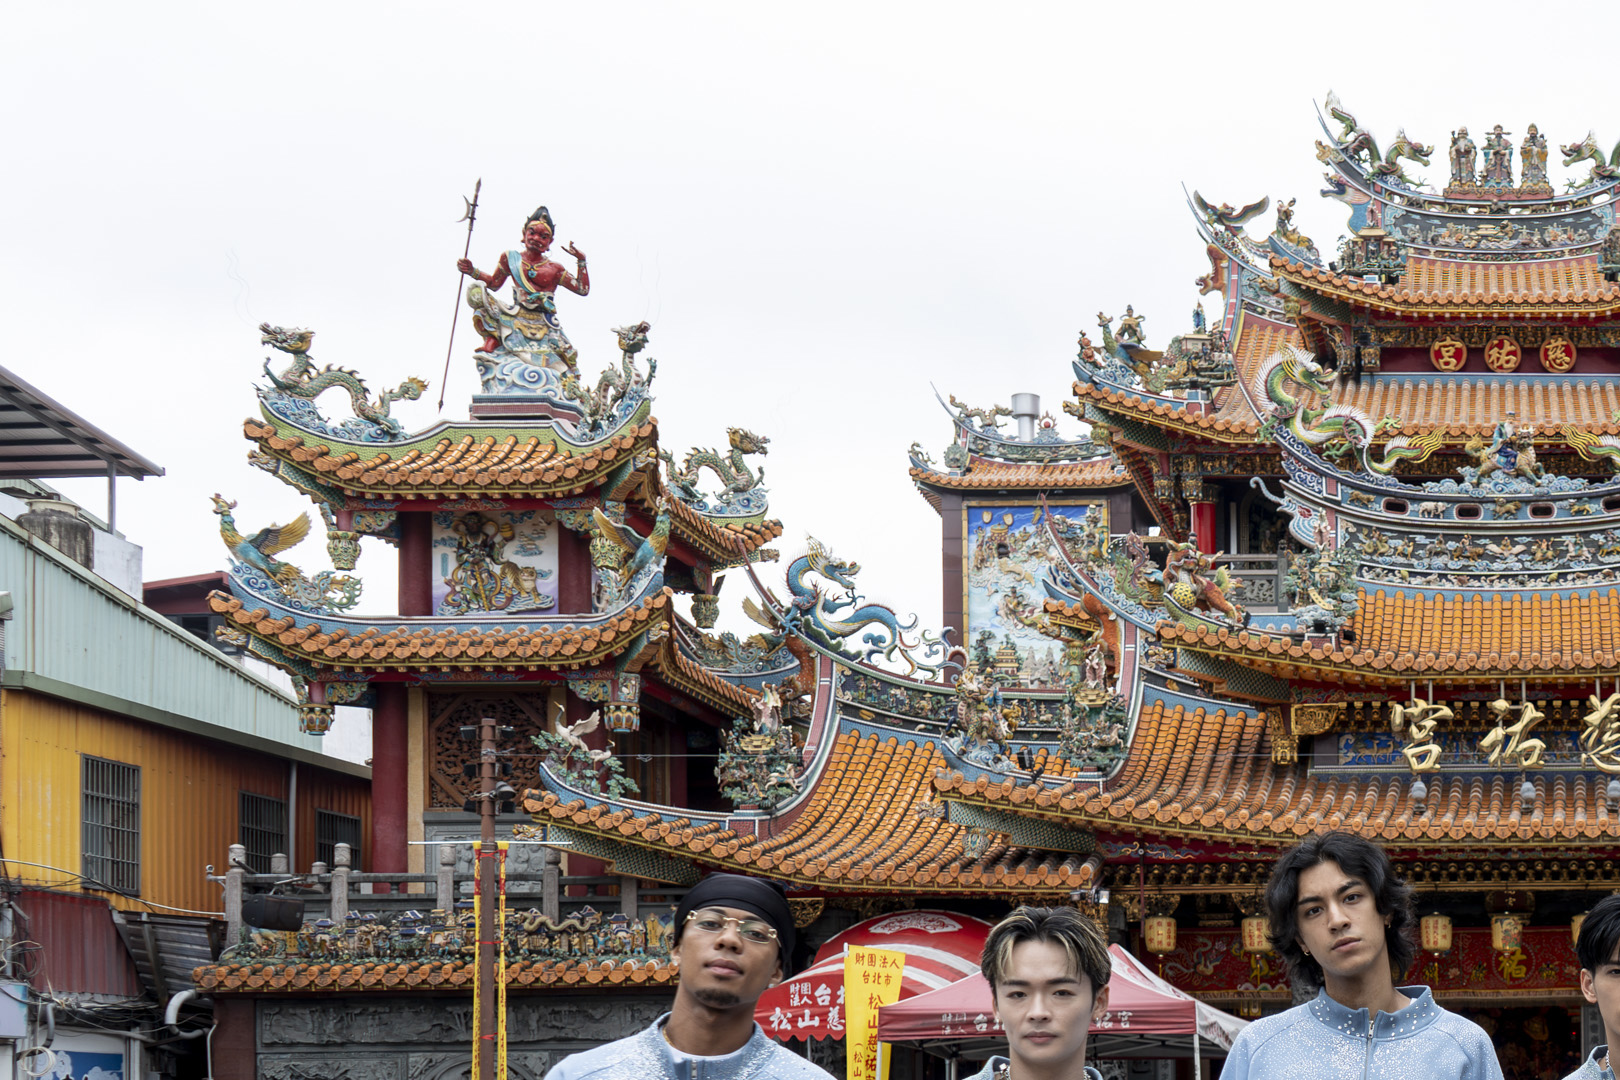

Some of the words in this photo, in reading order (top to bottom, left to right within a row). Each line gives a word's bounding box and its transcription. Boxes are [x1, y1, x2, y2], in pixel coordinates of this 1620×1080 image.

[855, 953, 900, 969] 財團法人
[862, 970, 893, 986] 台北市
